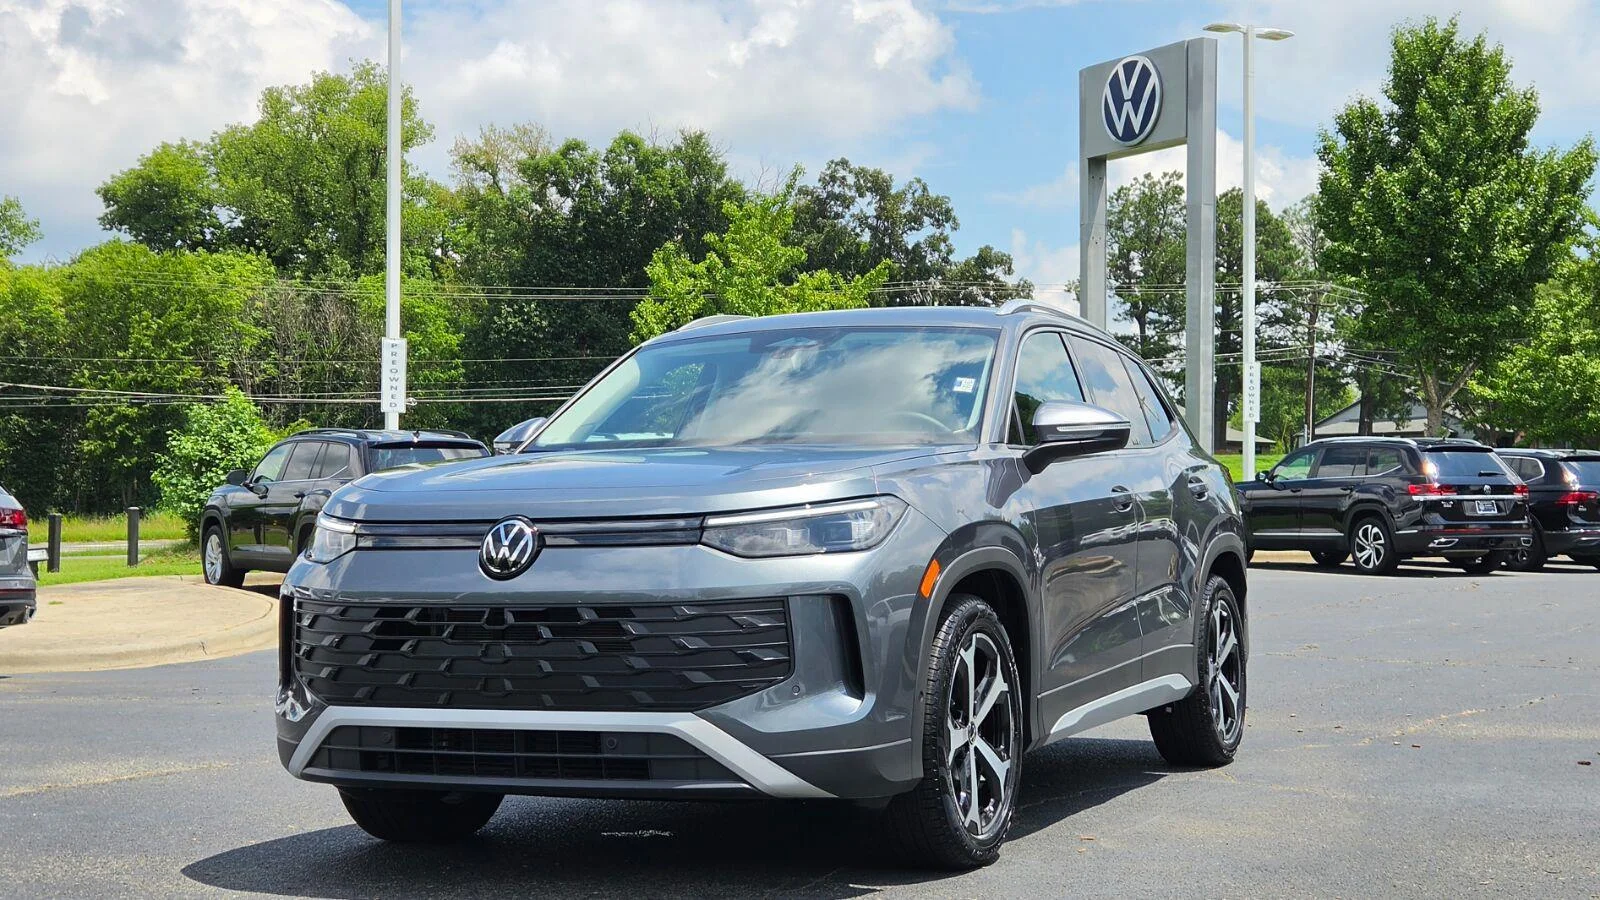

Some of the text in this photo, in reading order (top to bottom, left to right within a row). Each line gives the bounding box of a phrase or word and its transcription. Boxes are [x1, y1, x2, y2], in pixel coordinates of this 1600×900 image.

[1103, 57, 1159, 140] VW
[389, 342, 399, 408] PREOWNED
[485, 521, 531, 570] VW
